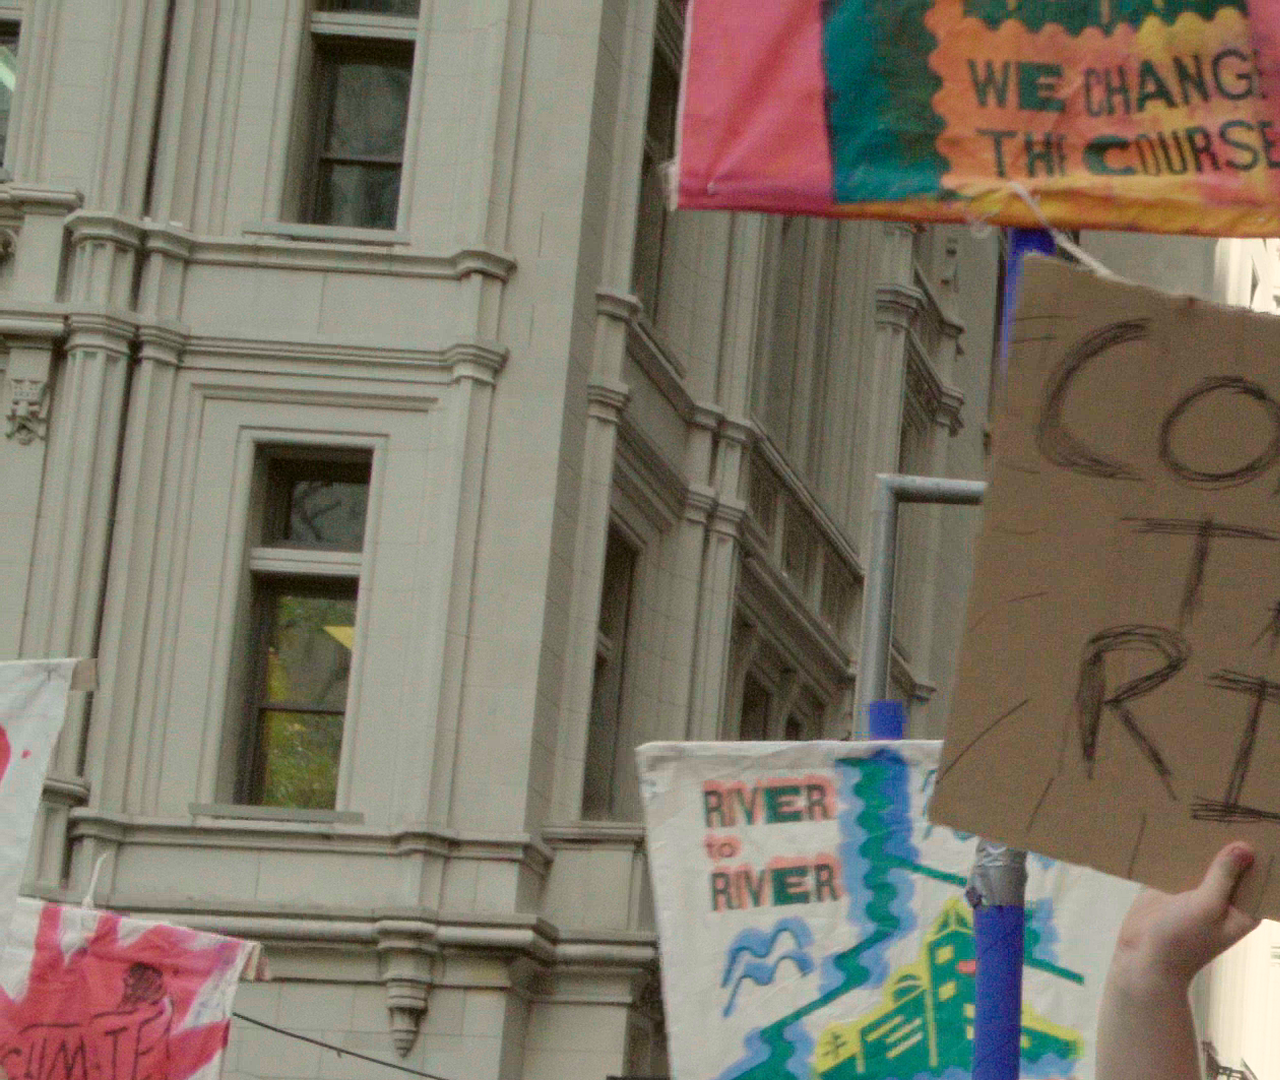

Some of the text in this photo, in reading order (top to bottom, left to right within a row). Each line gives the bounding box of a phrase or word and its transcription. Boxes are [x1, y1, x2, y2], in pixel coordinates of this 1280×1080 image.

[968, 58, 1066, 112] WE
[703, 777, 836, 828] RIVER
[704, 835, 742, 860] to
[711, 861, 842, 912] RIVER
